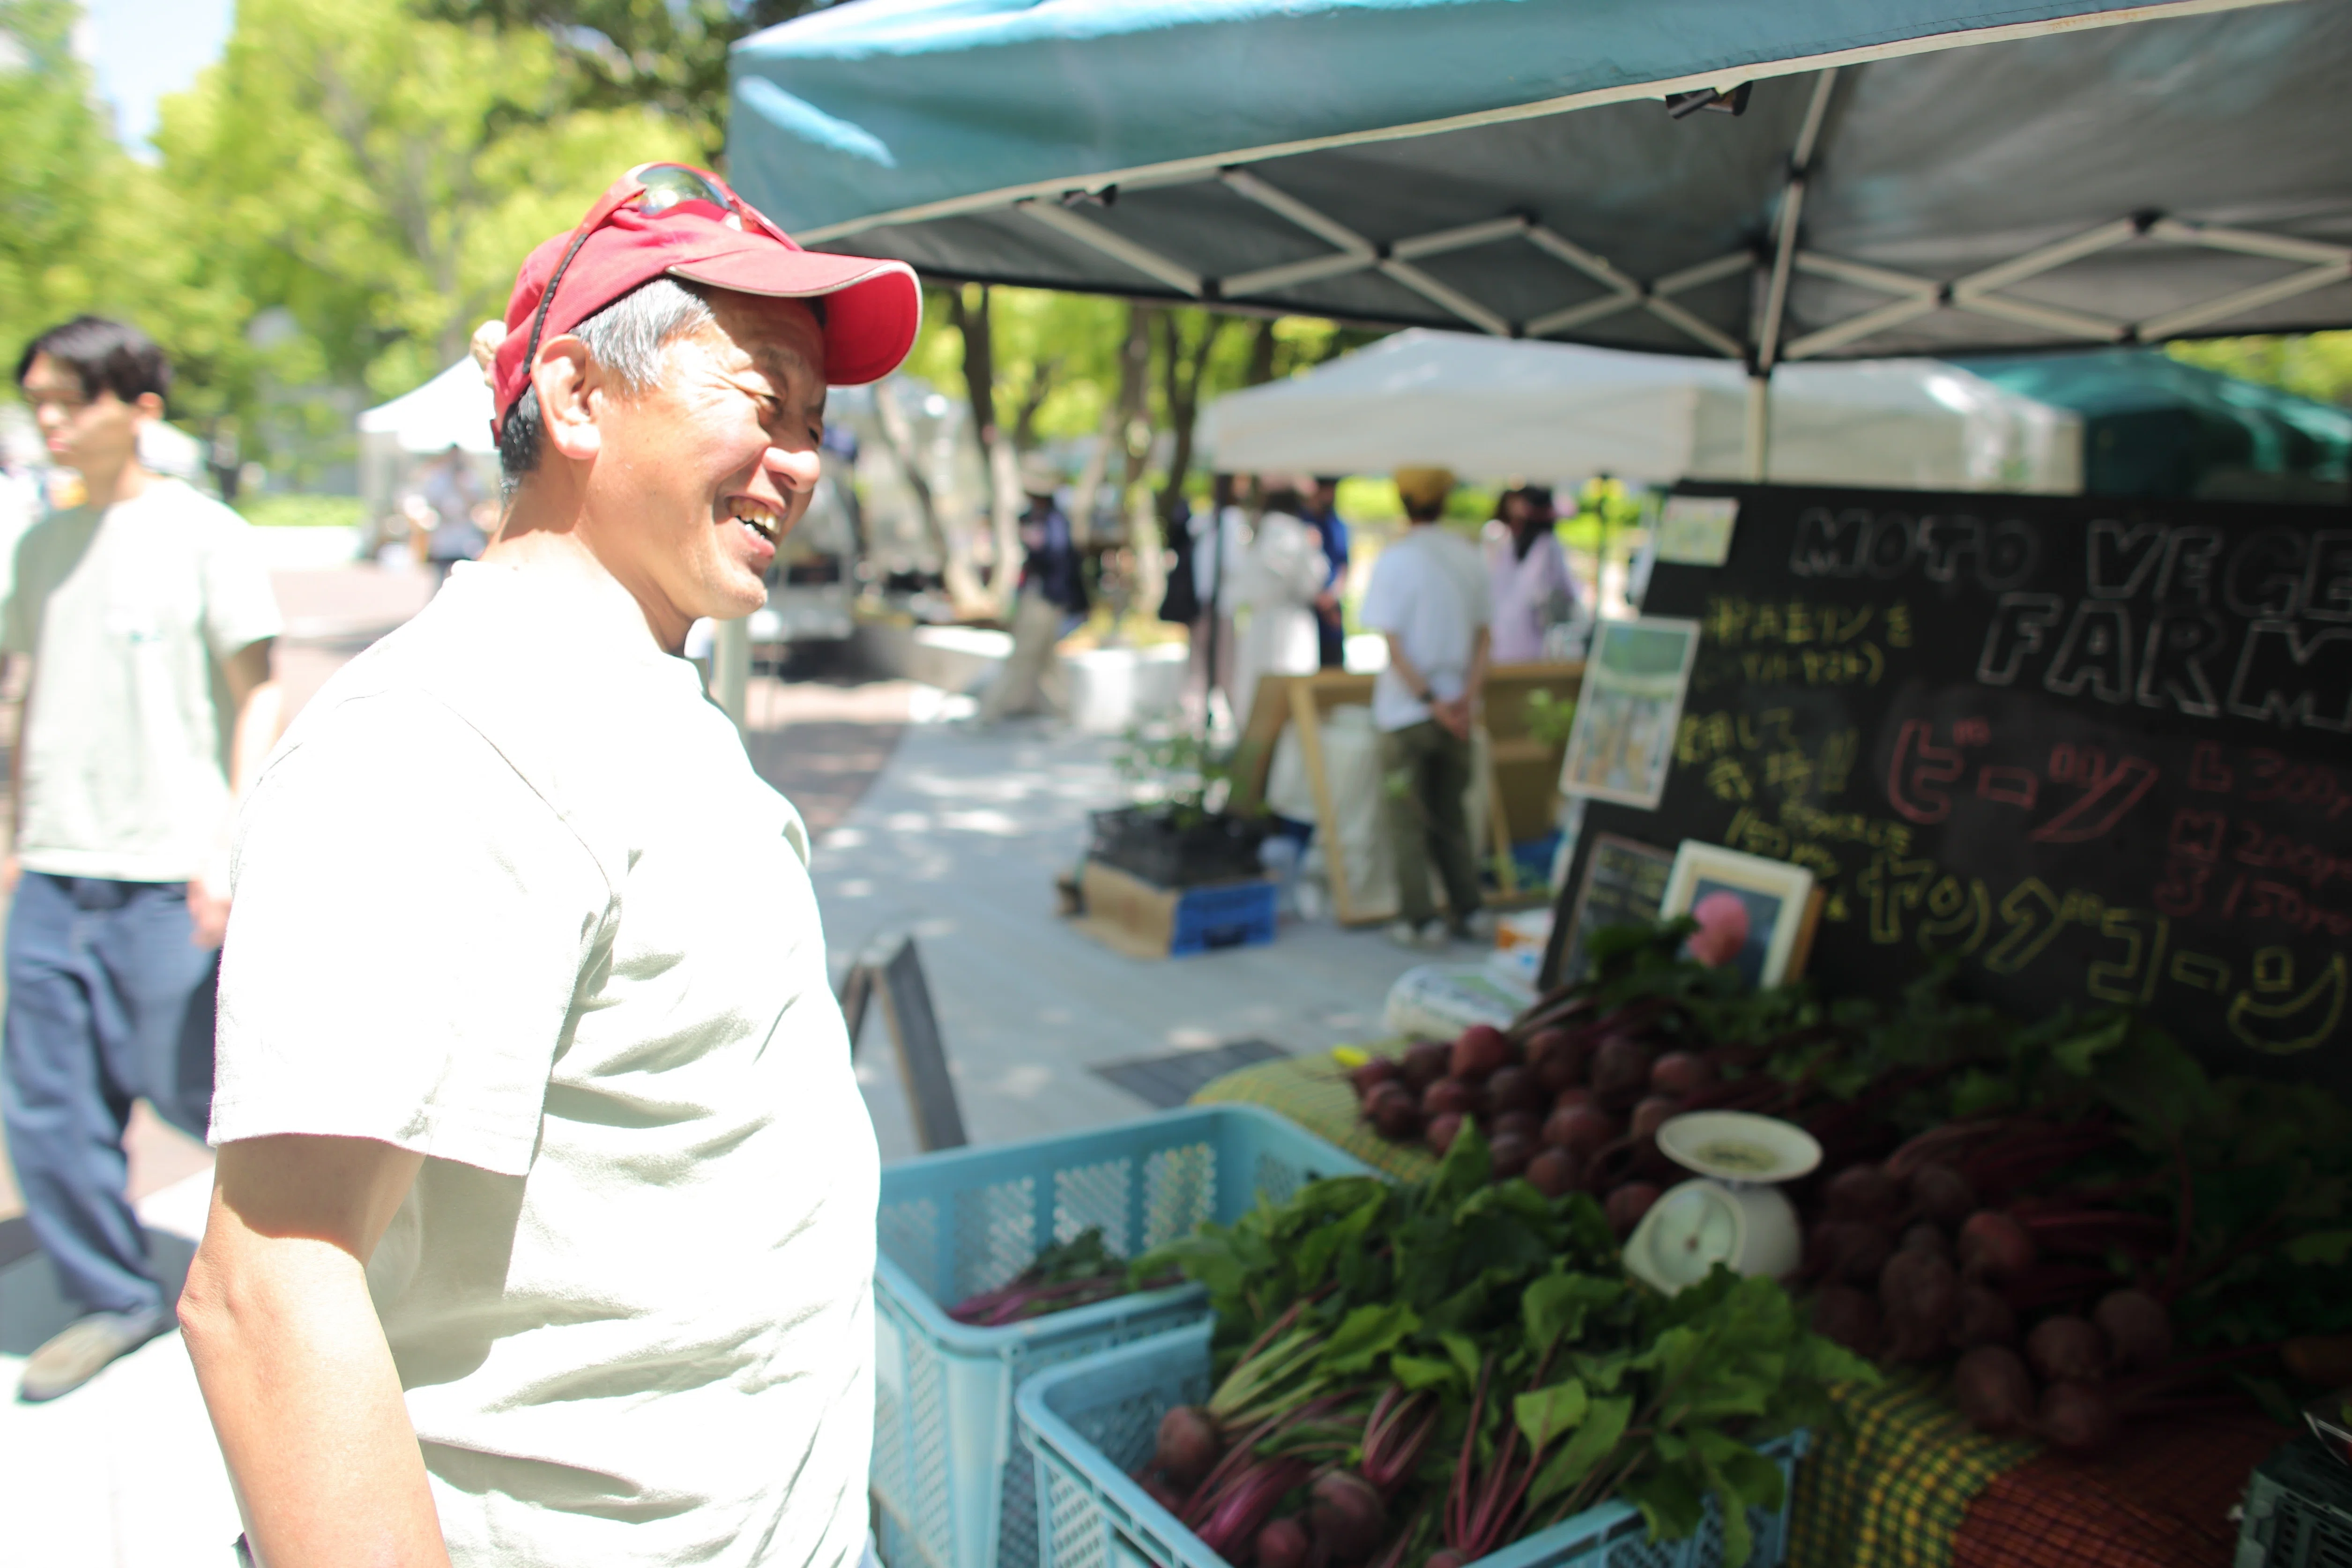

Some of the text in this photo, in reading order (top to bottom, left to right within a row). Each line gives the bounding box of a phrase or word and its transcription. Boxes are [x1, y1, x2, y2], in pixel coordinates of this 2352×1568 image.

[1788, 507, 2041, 591] MOTO
[1974, 591, 2352, 733] FARM
[1887, 717, 2159, 843] ビーツ
[1856, 850, 2346, 1056] ヤングコーン
